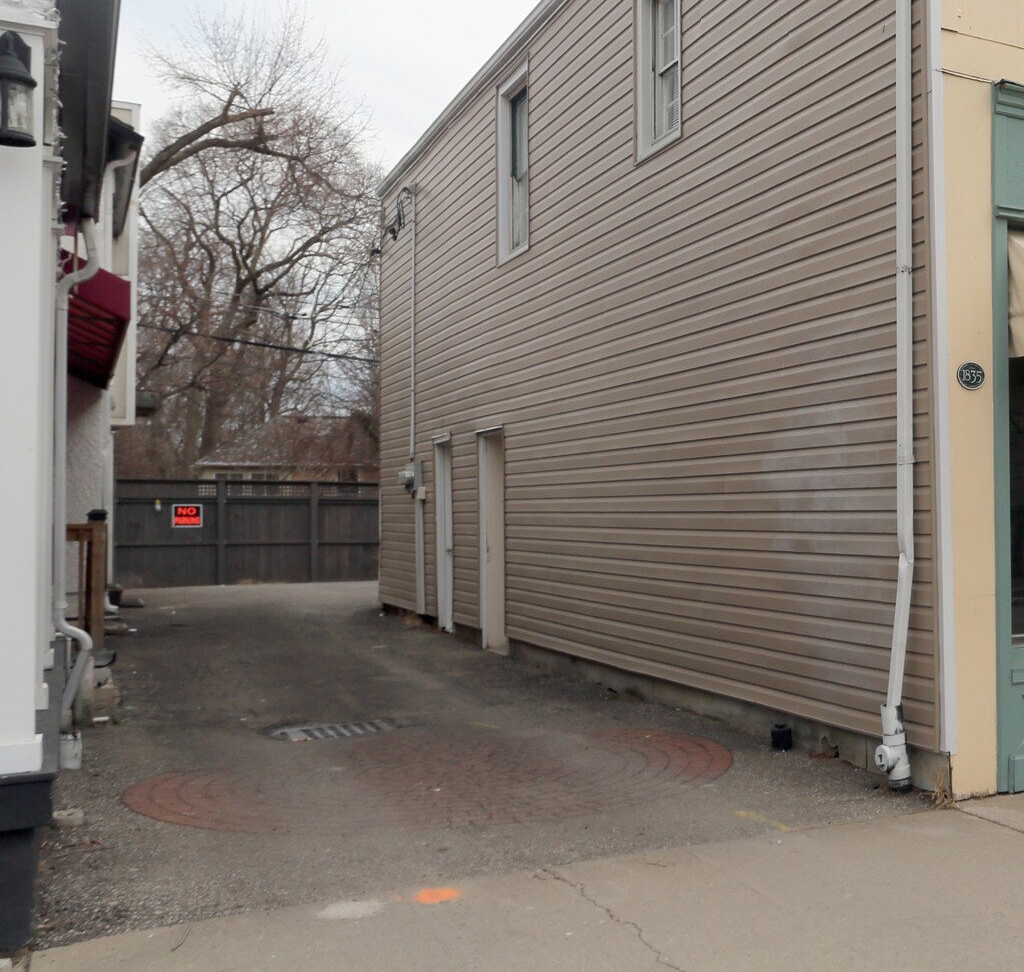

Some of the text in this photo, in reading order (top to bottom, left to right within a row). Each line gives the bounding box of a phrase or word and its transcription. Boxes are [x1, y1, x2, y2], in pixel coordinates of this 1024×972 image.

[962, 369, 982, 384] 1835
[177, 507, 197, 515] NO
[174, 516, 201, 525] PARKING
